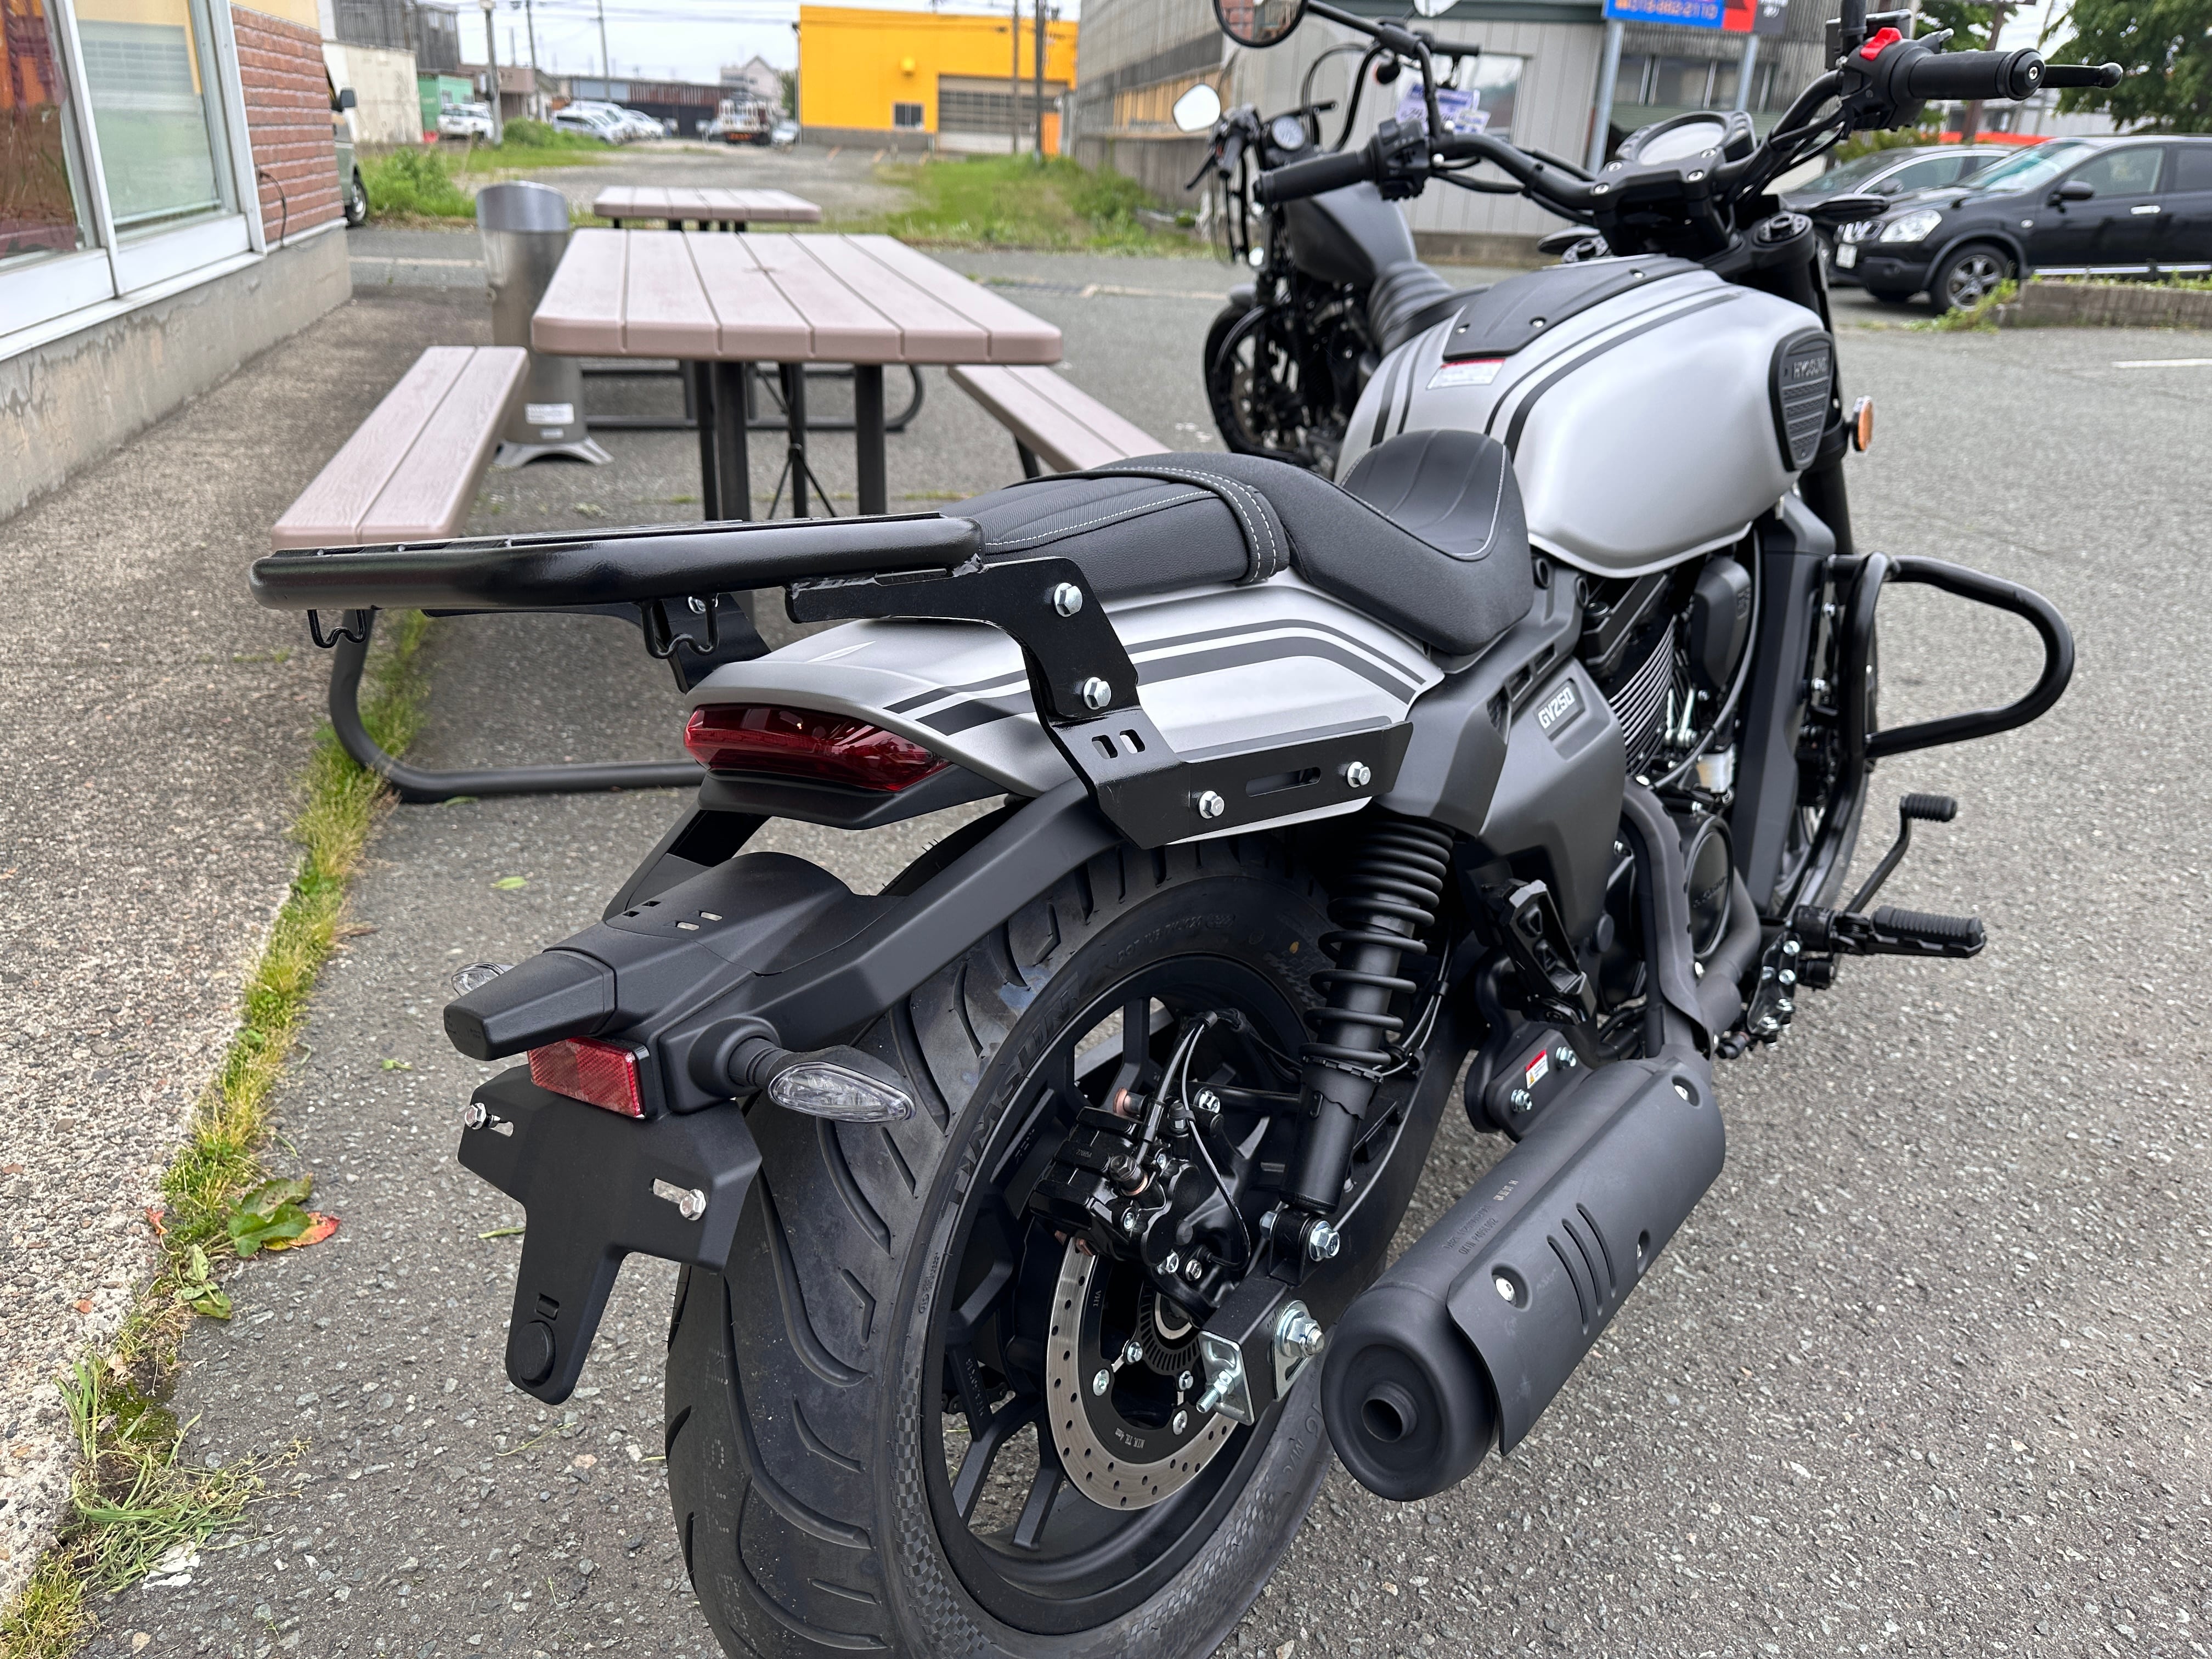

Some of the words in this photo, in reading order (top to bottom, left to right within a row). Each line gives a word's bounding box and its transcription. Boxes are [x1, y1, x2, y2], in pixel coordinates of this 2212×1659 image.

[1538, 686, 1576, 729] GV250
[940, 972, 1081, 1215] TIMSUN
[1283, 1438, 1304, 1472] M/C
